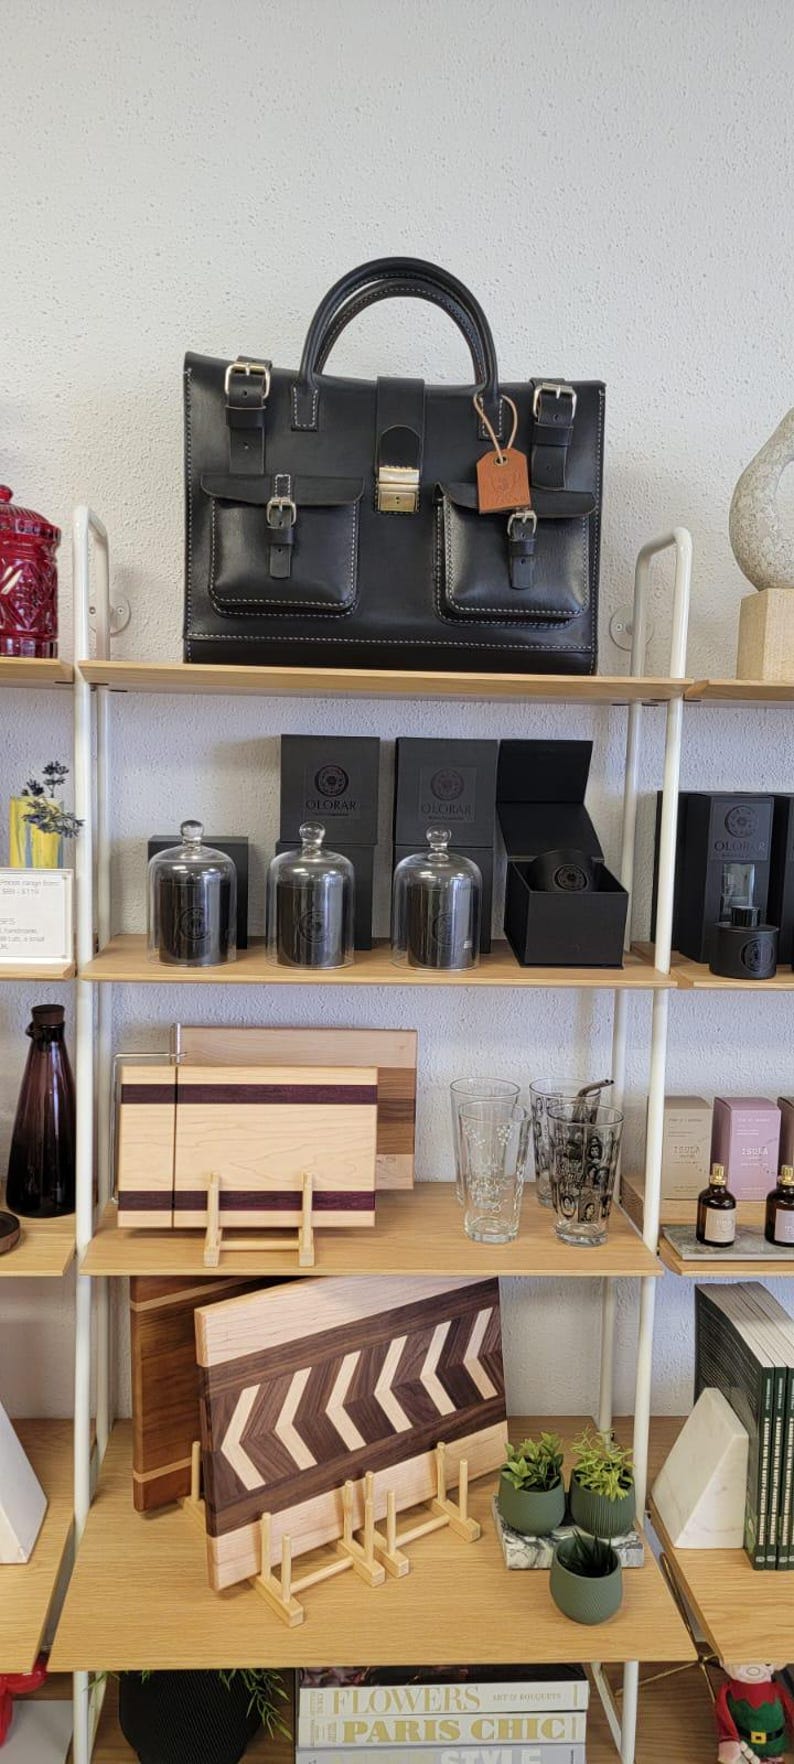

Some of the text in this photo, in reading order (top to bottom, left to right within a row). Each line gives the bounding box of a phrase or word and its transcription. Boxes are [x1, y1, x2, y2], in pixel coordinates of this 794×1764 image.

[305, 799, 357, 810] OLORAR
[333, 1685, 481, 1714] FLOWERS
[342, 1718, 461, 1743] PARIS
[470, 1717, 565, 1740] CHIC
